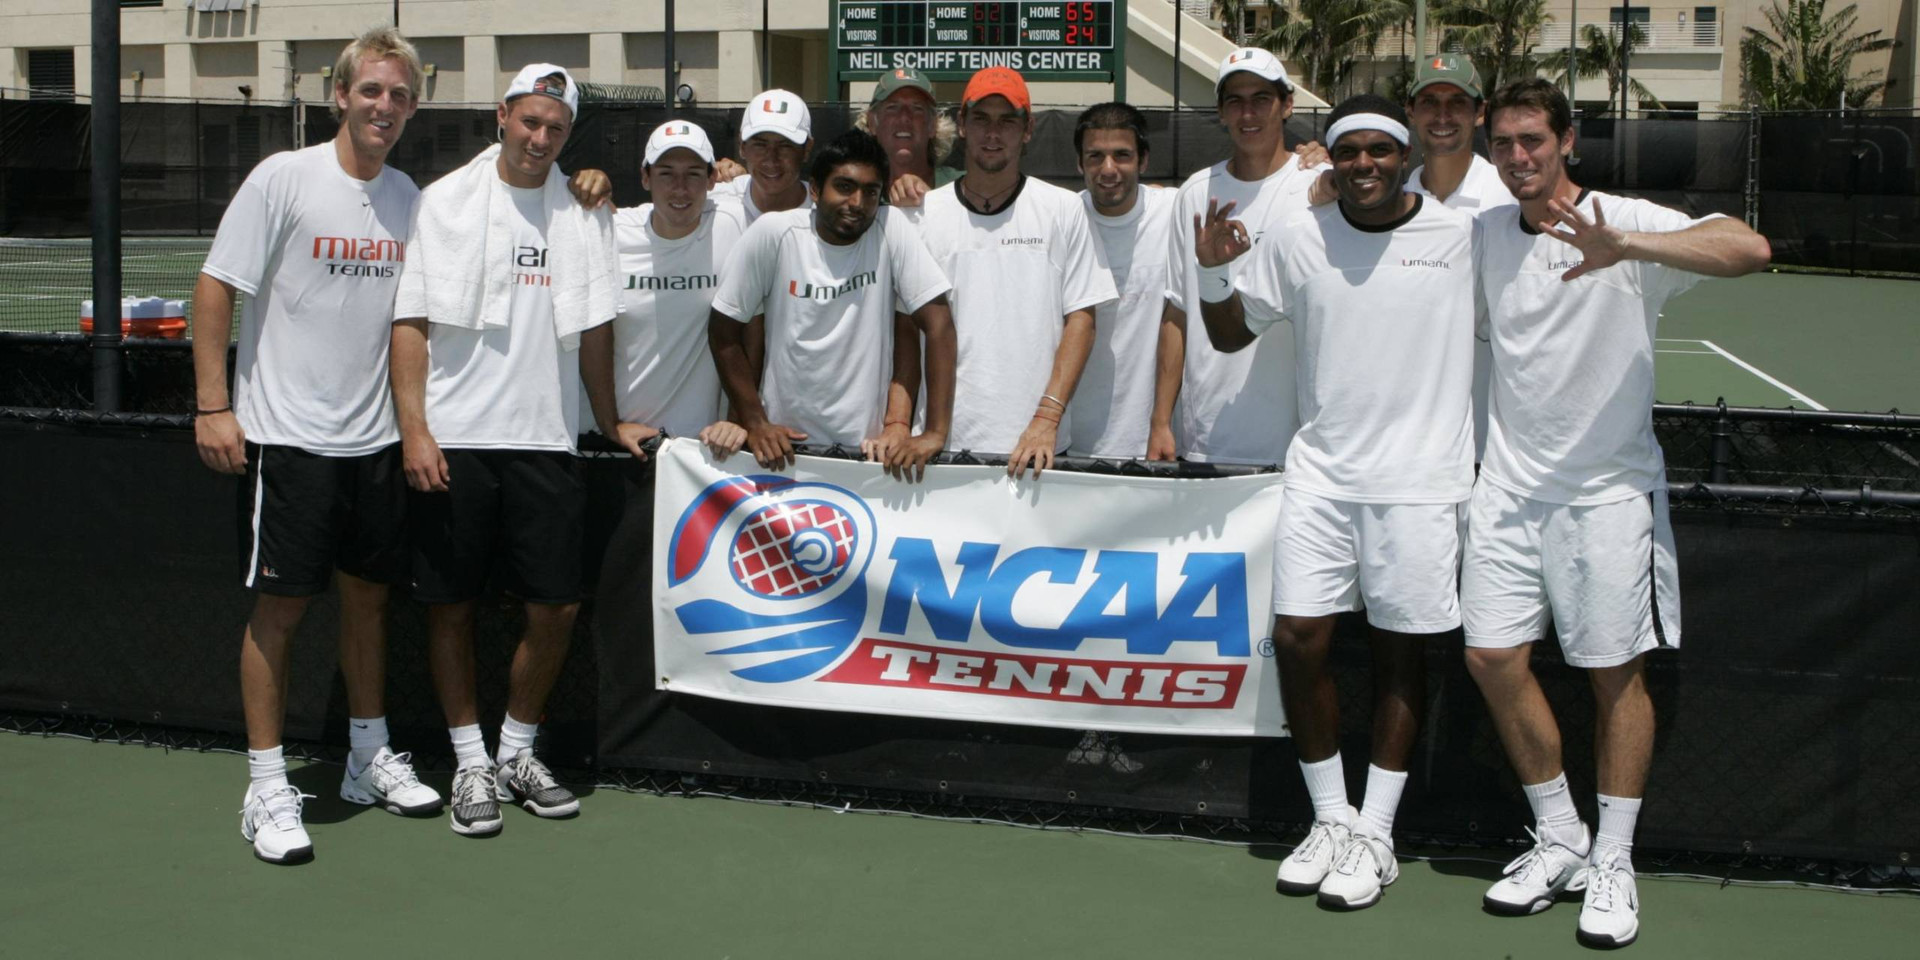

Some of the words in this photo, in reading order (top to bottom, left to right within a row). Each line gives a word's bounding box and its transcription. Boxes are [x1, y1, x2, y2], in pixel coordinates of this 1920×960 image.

[847, 8, 877, 19] HOME
[937, 7, 967, 19] HOME
[1029, 6, 1061, 18] HOME
[839, 18, 846, 30] 4
[929, 17, 936, 29] 5
[1021, 17, 1028, 29] 6
[846, 30, 877, 41] VISITORS
[936, 30, 968, 41] VISITORS
[1028, 29, 1060, 41] VISITORS
[850, 52, 888, 69] NEIL
[893, 52, 956, 69] SCHIFF
[958, 52, 1023, 69] TENNIS
[1028, 52, 1101, 69] CENTER
[879, 537, 1252, 658] NCAA
[871, 645, 1230, 703] TENNIS
